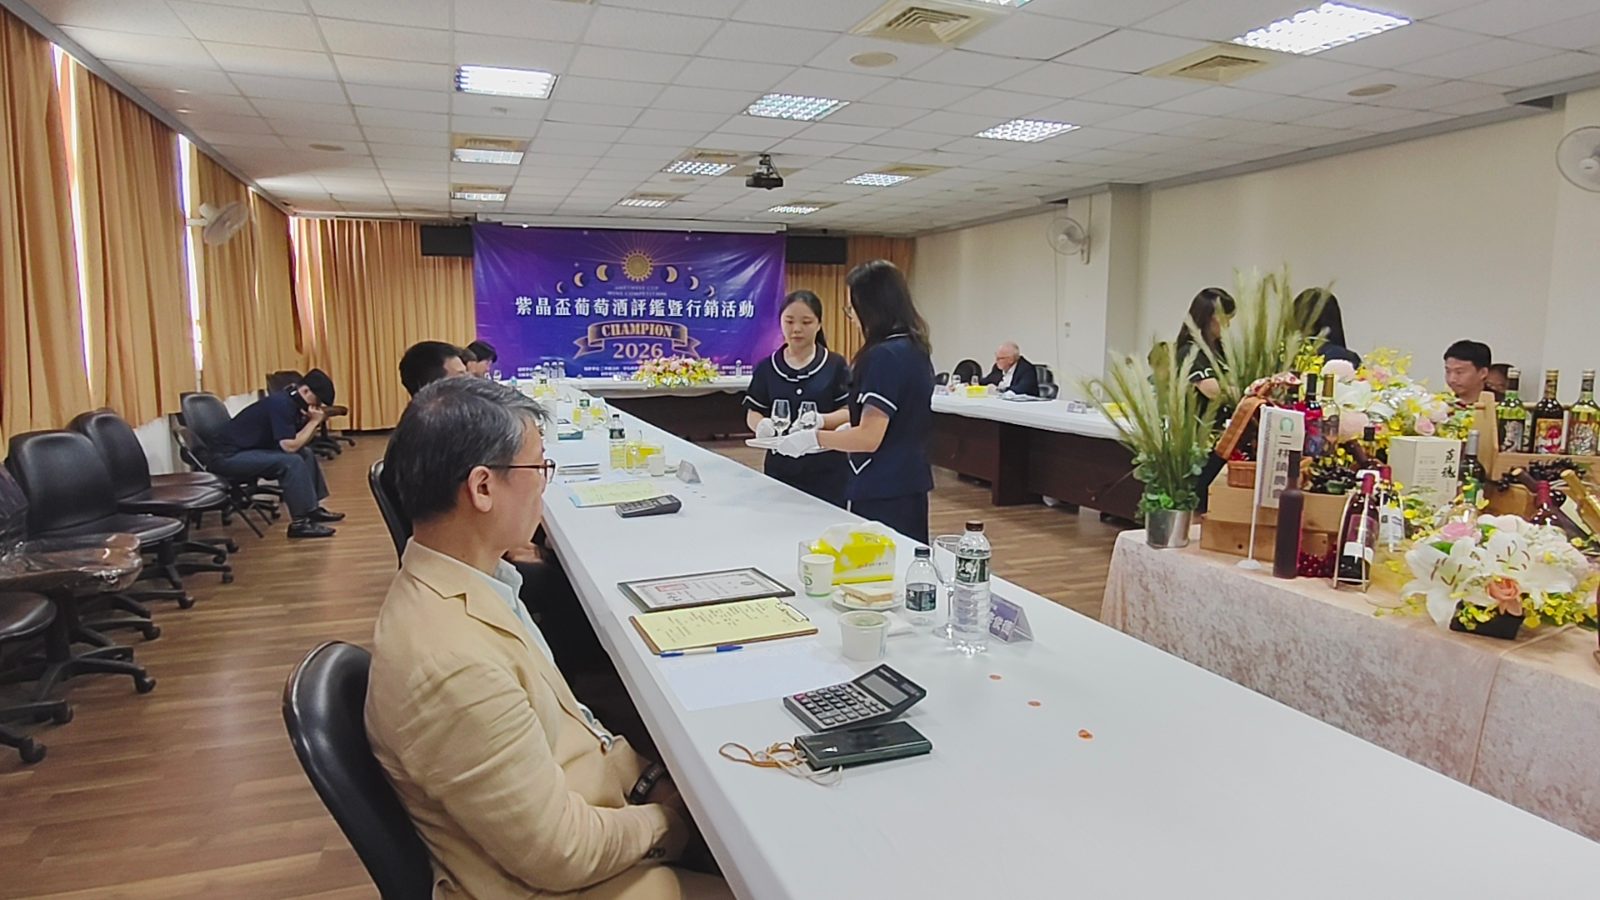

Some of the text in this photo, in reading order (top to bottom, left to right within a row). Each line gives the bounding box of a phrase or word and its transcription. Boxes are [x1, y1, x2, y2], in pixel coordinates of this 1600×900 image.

[514, 296, 755, 318] 紫晶盃葡萄酒評鑑暨行銷活動
[601, 322, 673, 338] CHAMPION
[612, 342, 664, 359] 2026
